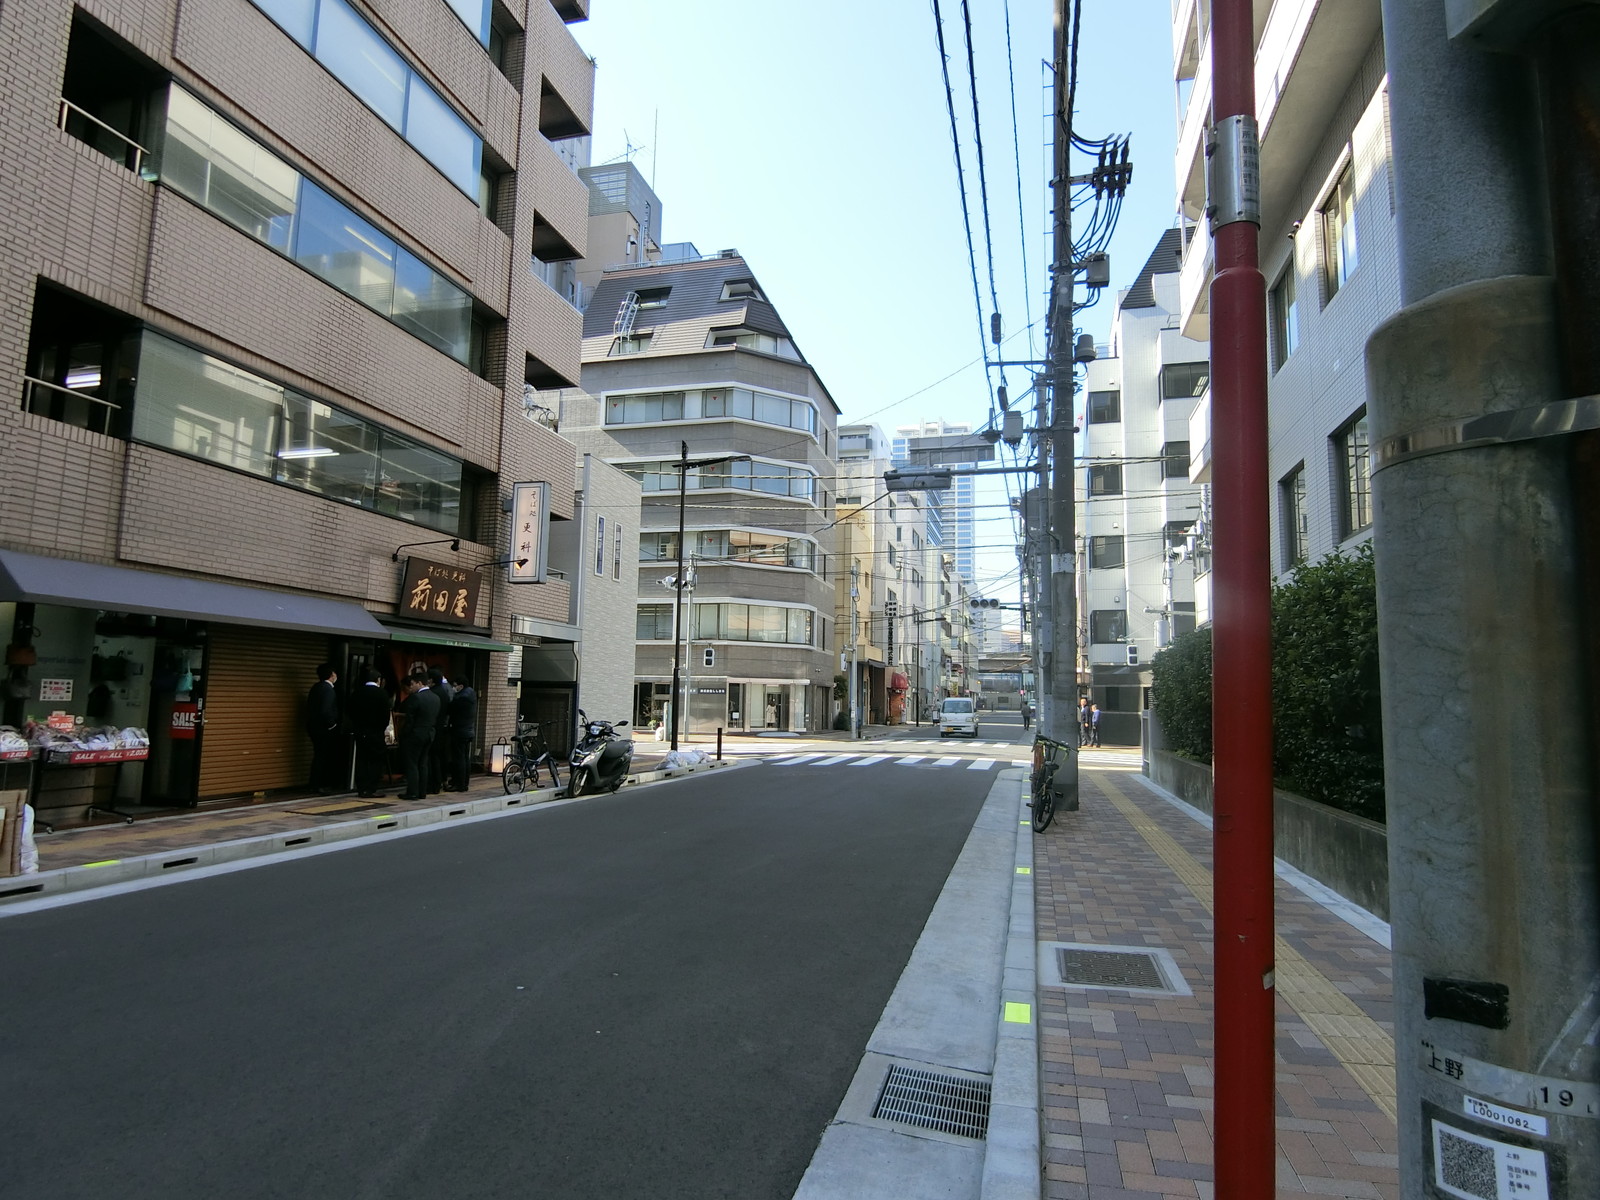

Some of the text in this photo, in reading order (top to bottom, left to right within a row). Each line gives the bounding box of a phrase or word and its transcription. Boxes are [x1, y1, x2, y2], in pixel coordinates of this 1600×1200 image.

[529, 490, 537, 517] そば処
[520, 522, 532, 553] 更科
[427, 565, 467, 583] そば処 更科
[409, 577, 469, 619] 前田屋
[172, 711, 196, 727] SALE
[75, 752, 96, 760] SALE
[1428, 1051, 1464, 1081] 上野
[1540, 1085, 1574, 1108] 19
[1506, 1152, 1520, 1160] 上野
